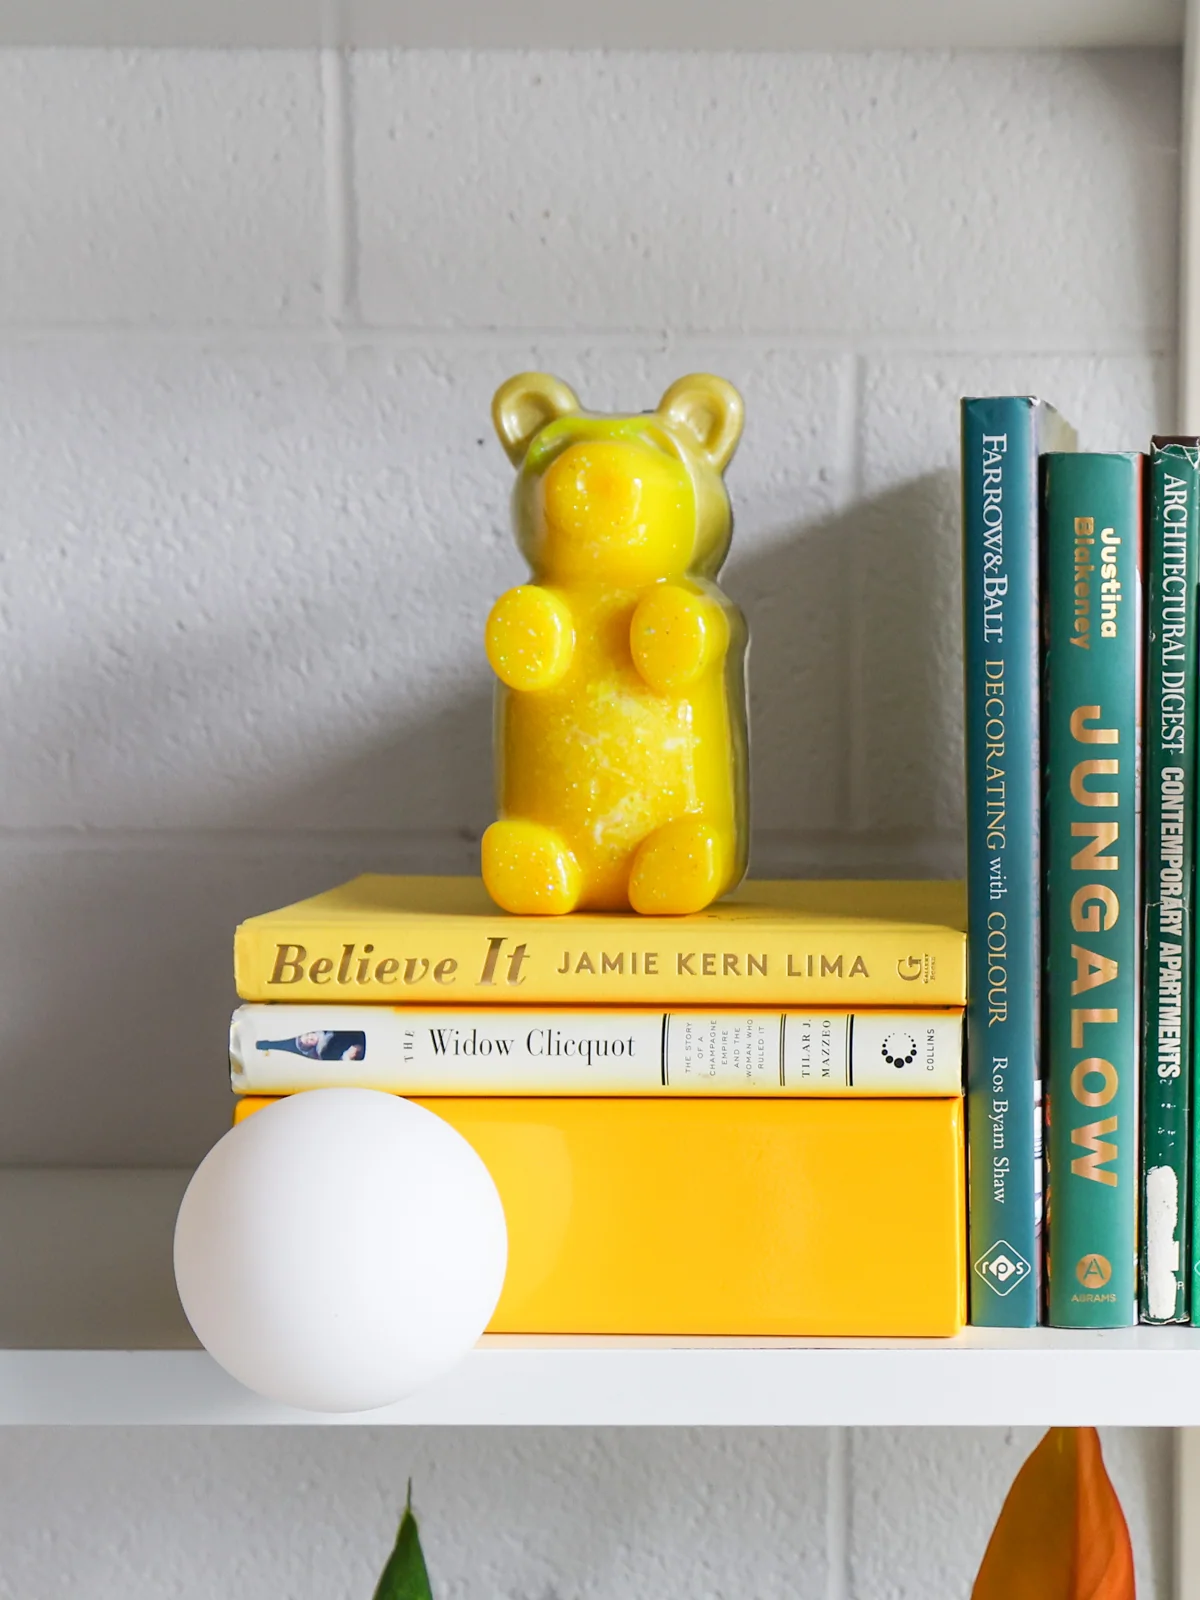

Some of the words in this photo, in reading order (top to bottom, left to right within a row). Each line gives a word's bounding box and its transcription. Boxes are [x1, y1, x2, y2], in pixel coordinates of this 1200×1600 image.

[1070, 517, 1095, 649] Blakeney
[1100, 528, 1122, 638] Justina
[1161, 473, 1188, 665] ARCHITECTURAL
[1161, 671, 1185, 754] DIGEST
[985, 660, 1006, 850] DECORATING
[1159, 767, 1185, 936] CONTEMPORARY
[989, 857, 1007, 900] with
[266, 943, 458, 986] Believe
[475, 937, 530, 986] It
[557, 951, 659, 974] JAMIE
[677, 953, 768, 977] KERN
[787, 954, 870, 978] LIMA
[987, 912, 1008, 1027] COLOUR
[1070, 705, 1119, 1187] JUNGALOW
[758, 1026, 764, 1035] IT
[801, 1019, 811, 1029] J.
[1158, 942, 1182, 1078] APARTMENTS
[404, 1029, 415, 1062] THE
[429, 1028, 514, 1057] Widow
[526, 1028, 636, 1066] Clicquot
[697, 1046, 704, 1059] OF
[709, 1019, 717, 1076] CHAMPAGNE
[802, 1035, 811, 1077] TILAR
[822, 1020, 831, 1077] MAZZEO
[926, 1028, 935, 1071] COLLINS
[992, 1057, 1008, 1093] Ros
[988, 1100, 1009, 1149] Byam
[993, 1157, 1010, 1204] Shaw
[1071, 1293, 1117, 1303] ABRAMS
